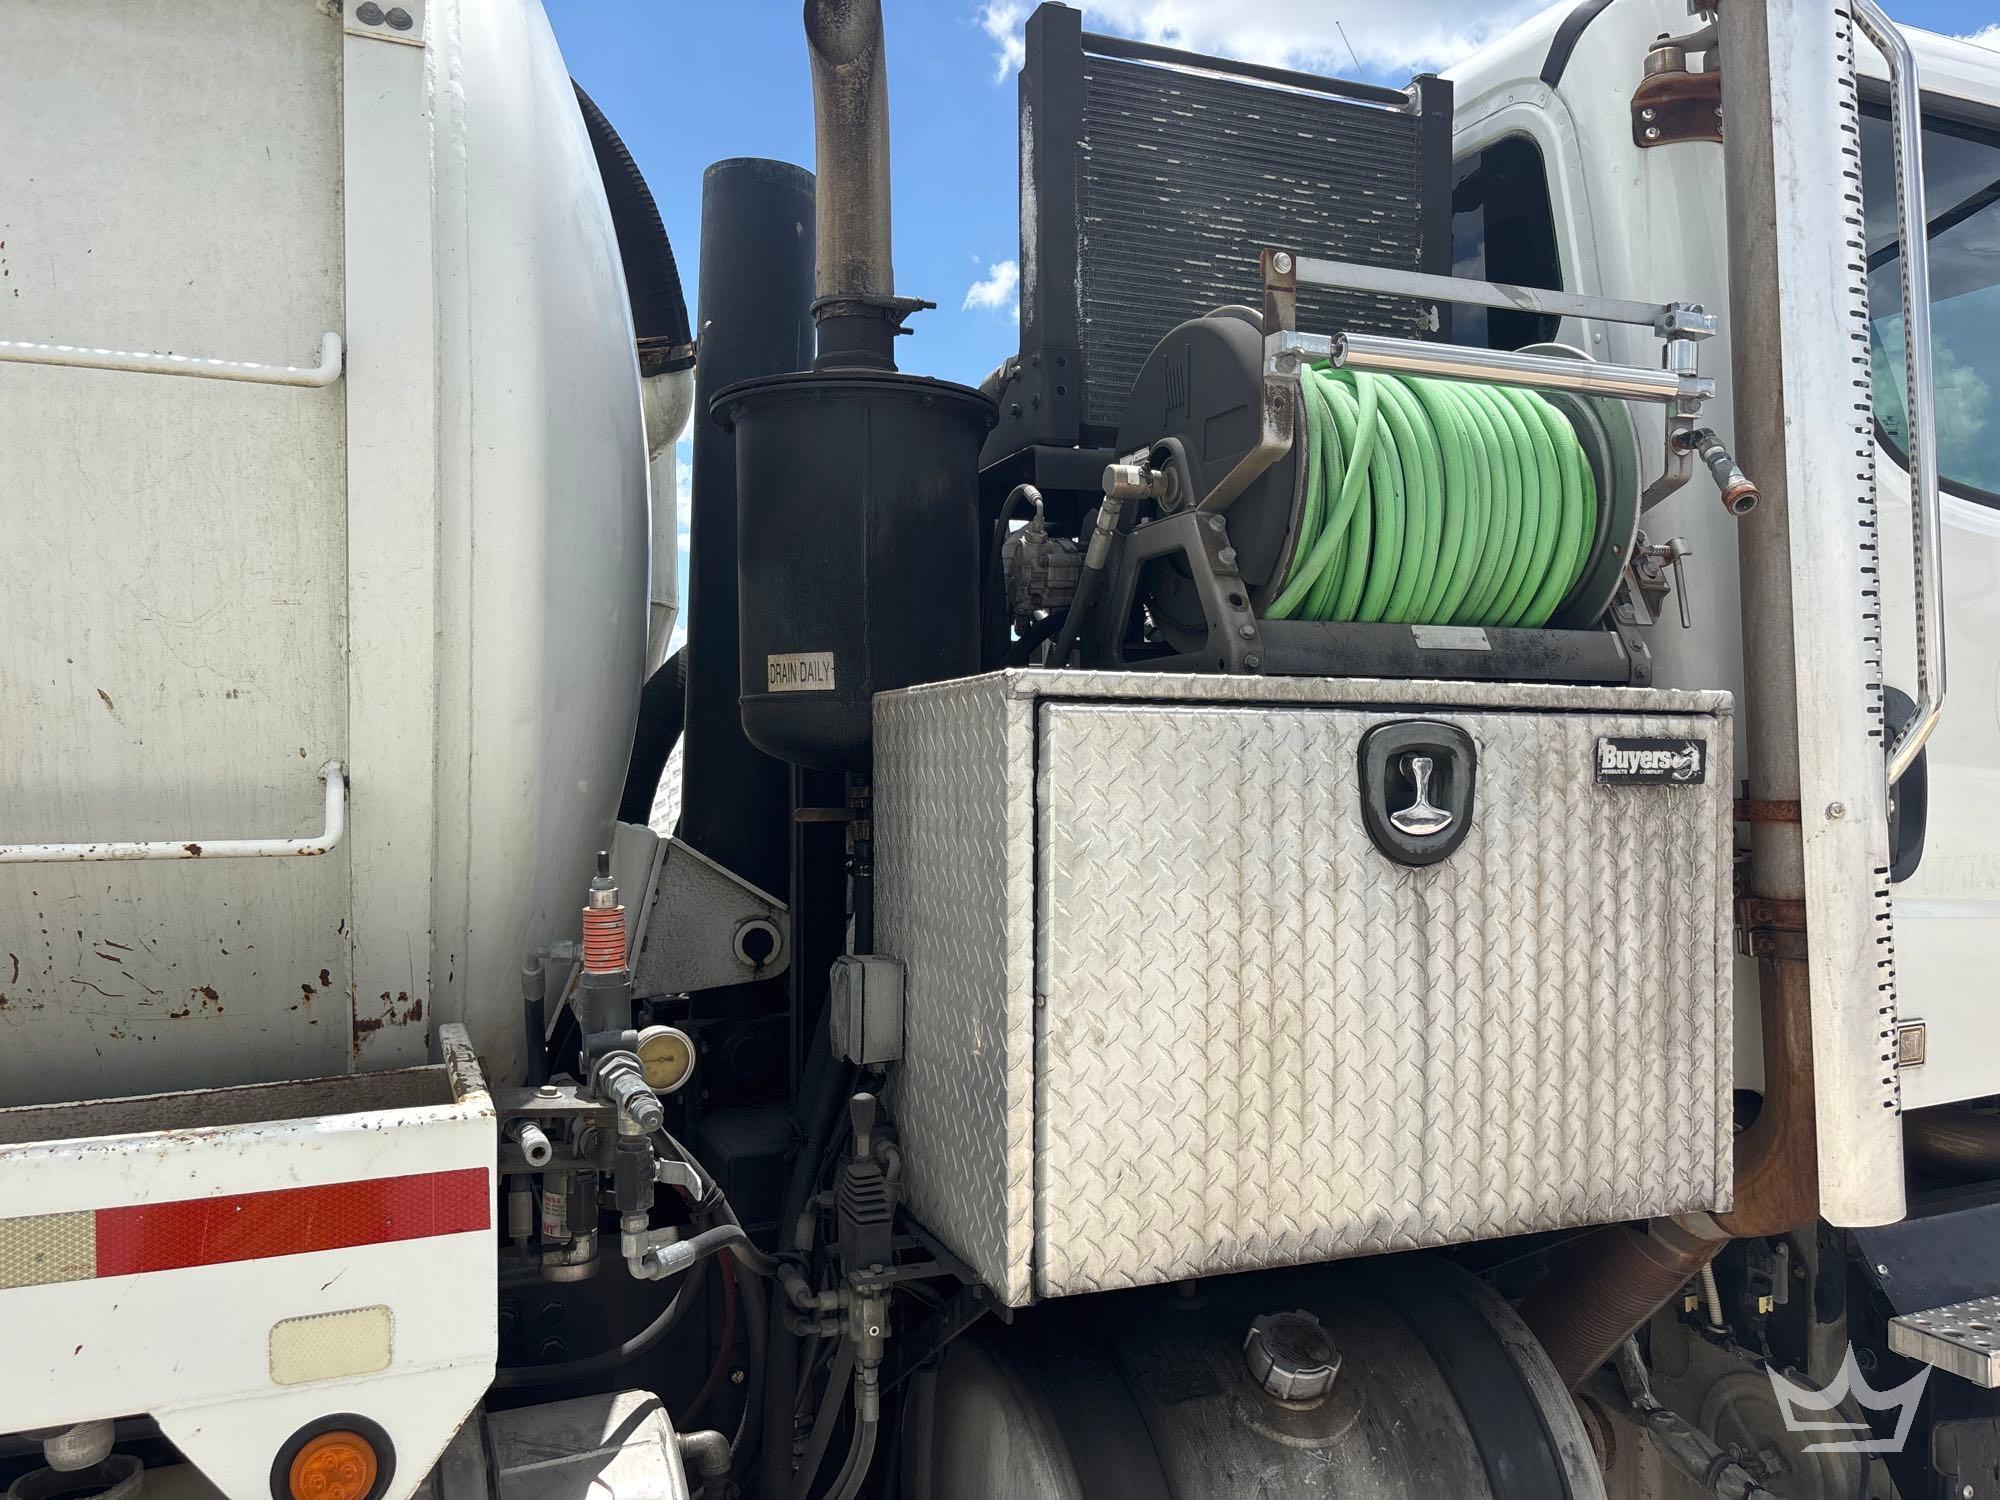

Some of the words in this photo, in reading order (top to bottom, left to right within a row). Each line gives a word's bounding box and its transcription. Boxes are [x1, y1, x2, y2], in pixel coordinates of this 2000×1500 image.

[769, 662, 797, 684] DRAIN
[800, 661, 830, 682] DAILY
[1601, 744, 1671, 774] Buyers
